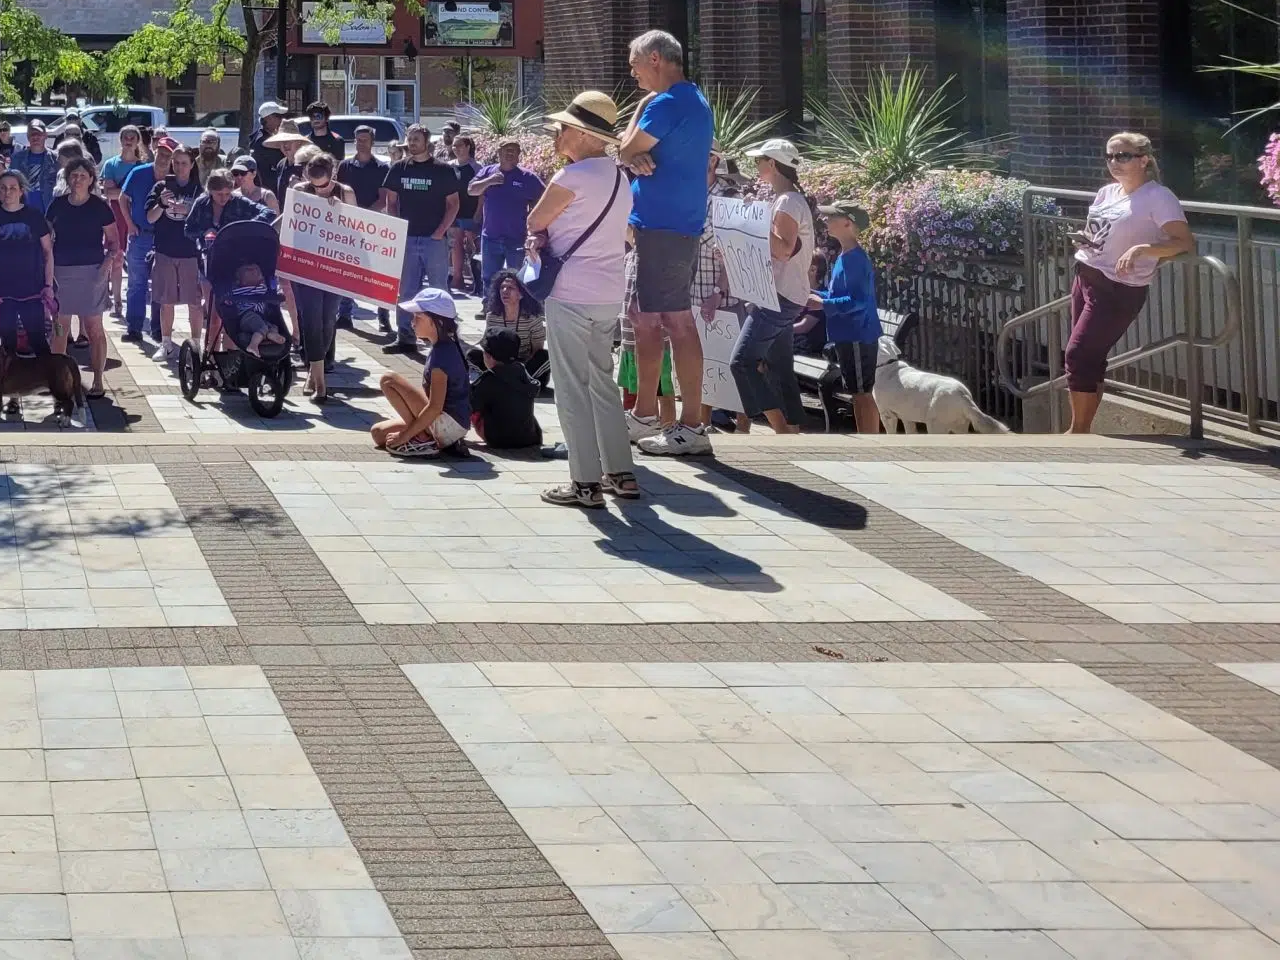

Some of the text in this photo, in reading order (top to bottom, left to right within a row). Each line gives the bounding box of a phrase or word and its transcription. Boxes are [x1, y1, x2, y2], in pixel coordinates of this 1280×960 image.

[288, 218, 397, 259] NOT speak for all
[293, 202, 397, 241] CNO & RNAO do
[297, 256, 315, 266] nurse.
[319, 262, 342, 276] respect
[342, 269, 364, 281] patient
[363, 275, 396, 291] autonomy.
[317, 245, 361, 265] nurses
